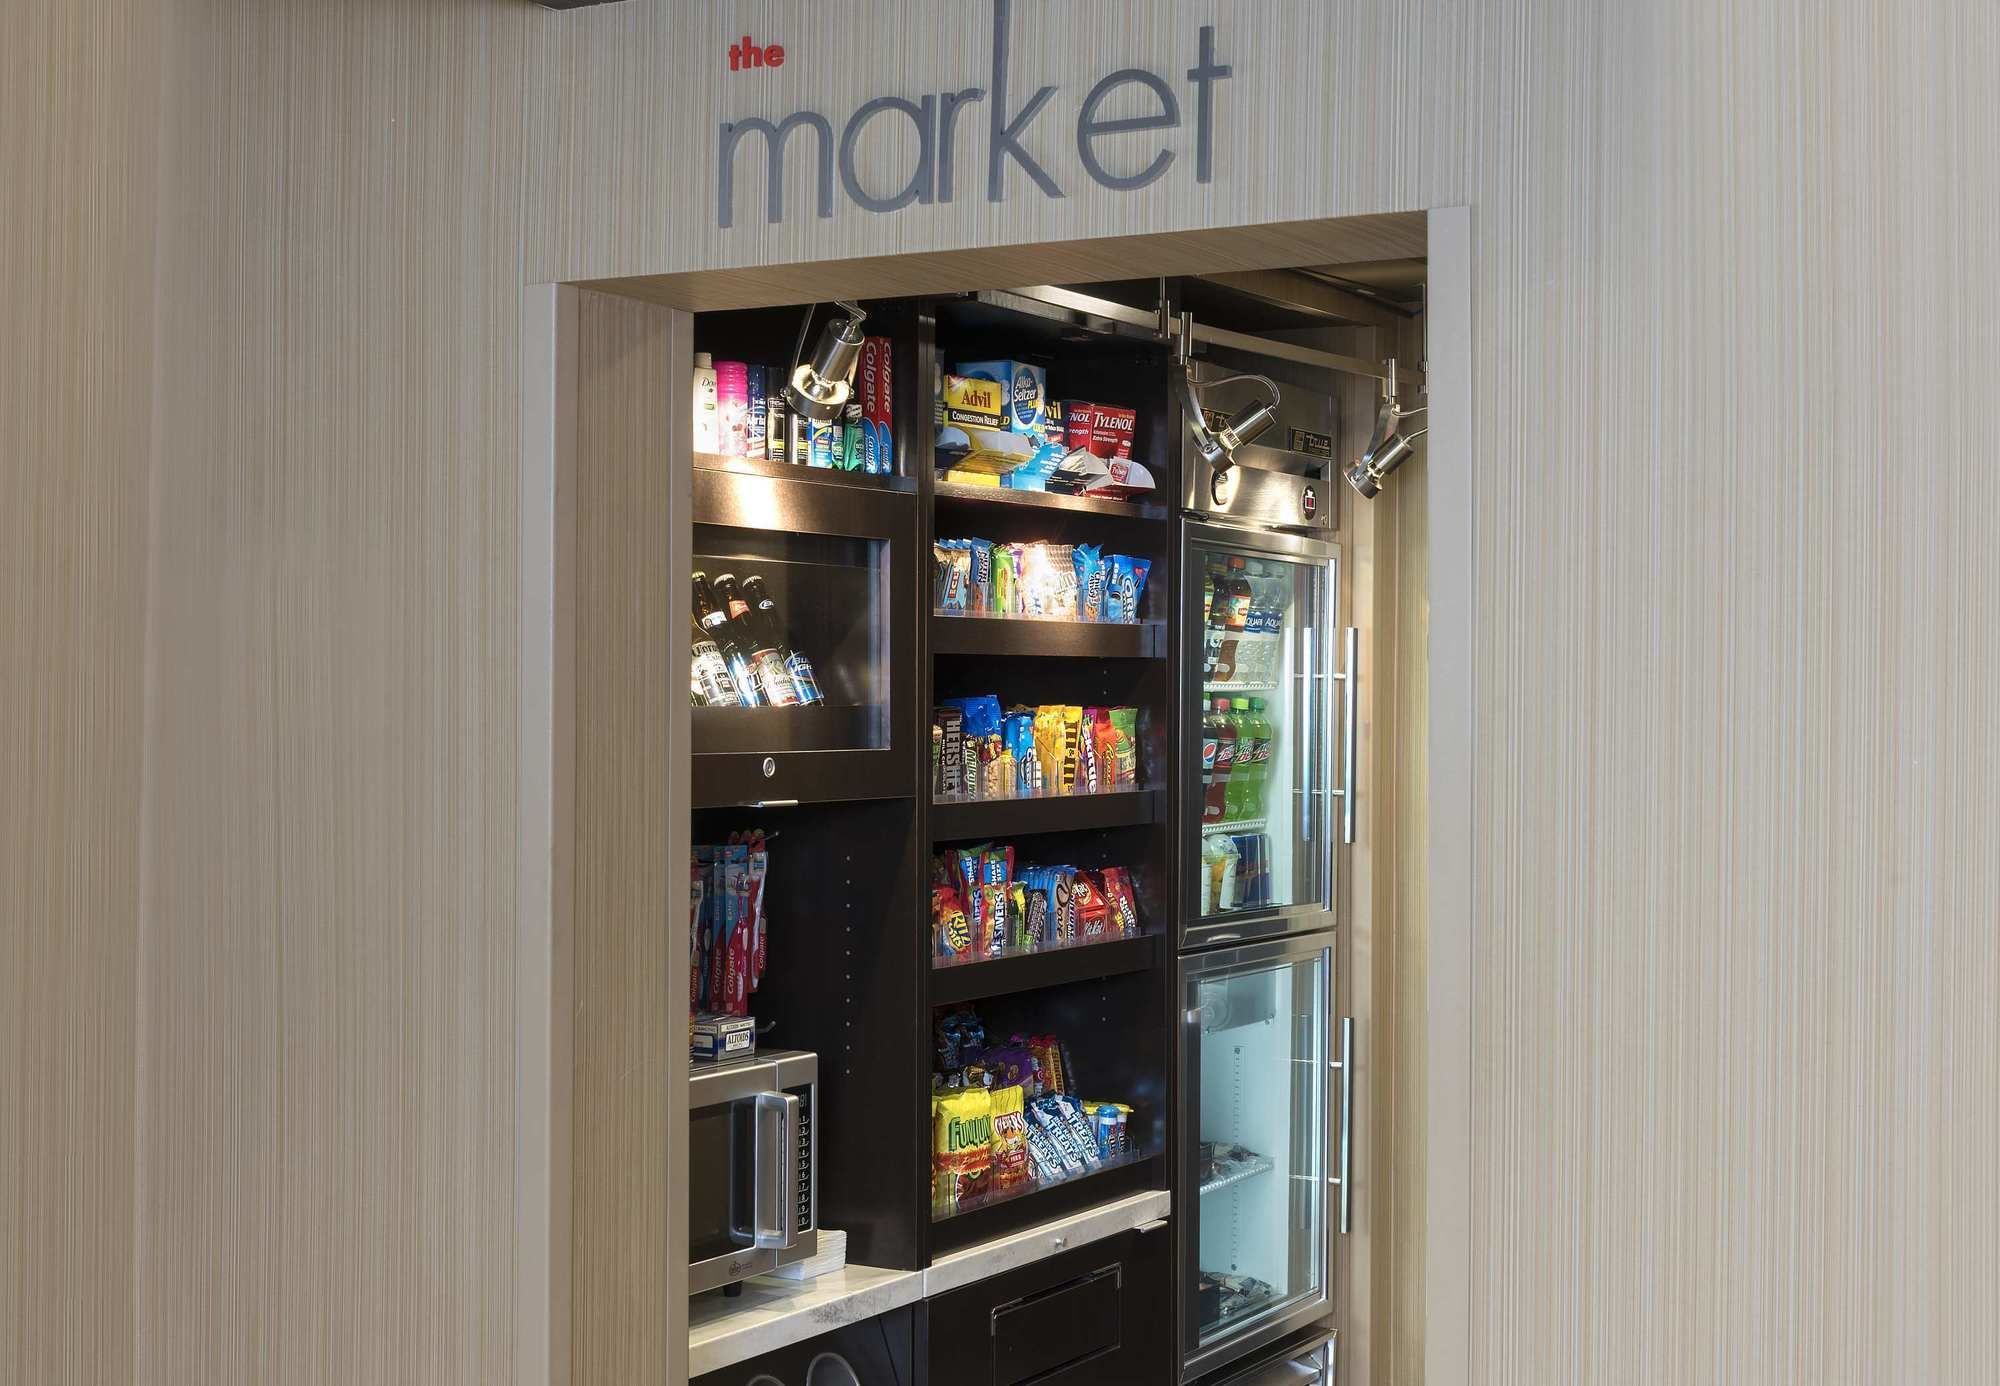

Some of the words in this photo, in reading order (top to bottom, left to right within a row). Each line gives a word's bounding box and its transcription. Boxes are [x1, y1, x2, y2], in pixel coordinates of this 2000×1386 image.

[729, 36, 785, 71] the
[717, 0, 1233, 230] market
[864, 342, 877, 413] Colgate
[882, 342, 892, 414] Colgate
[952, 410, 984, 424] CONGESTION
[984, 415, 999, 426] RELIEF
[961, 389, 992, 408] Advil
[1094, 412, 1133, 431] TYLENOL
[1305, 434, 1330, 450] true
[713, 948, 721, 993] Colgate
[759, 936, 767, 968] Colgate
[1027, 1128, 1058, 1169] TREATS
[1046, 1118, 1079, 1163] TREATS
[1069, 1112, 1096, 1158] TREATS
